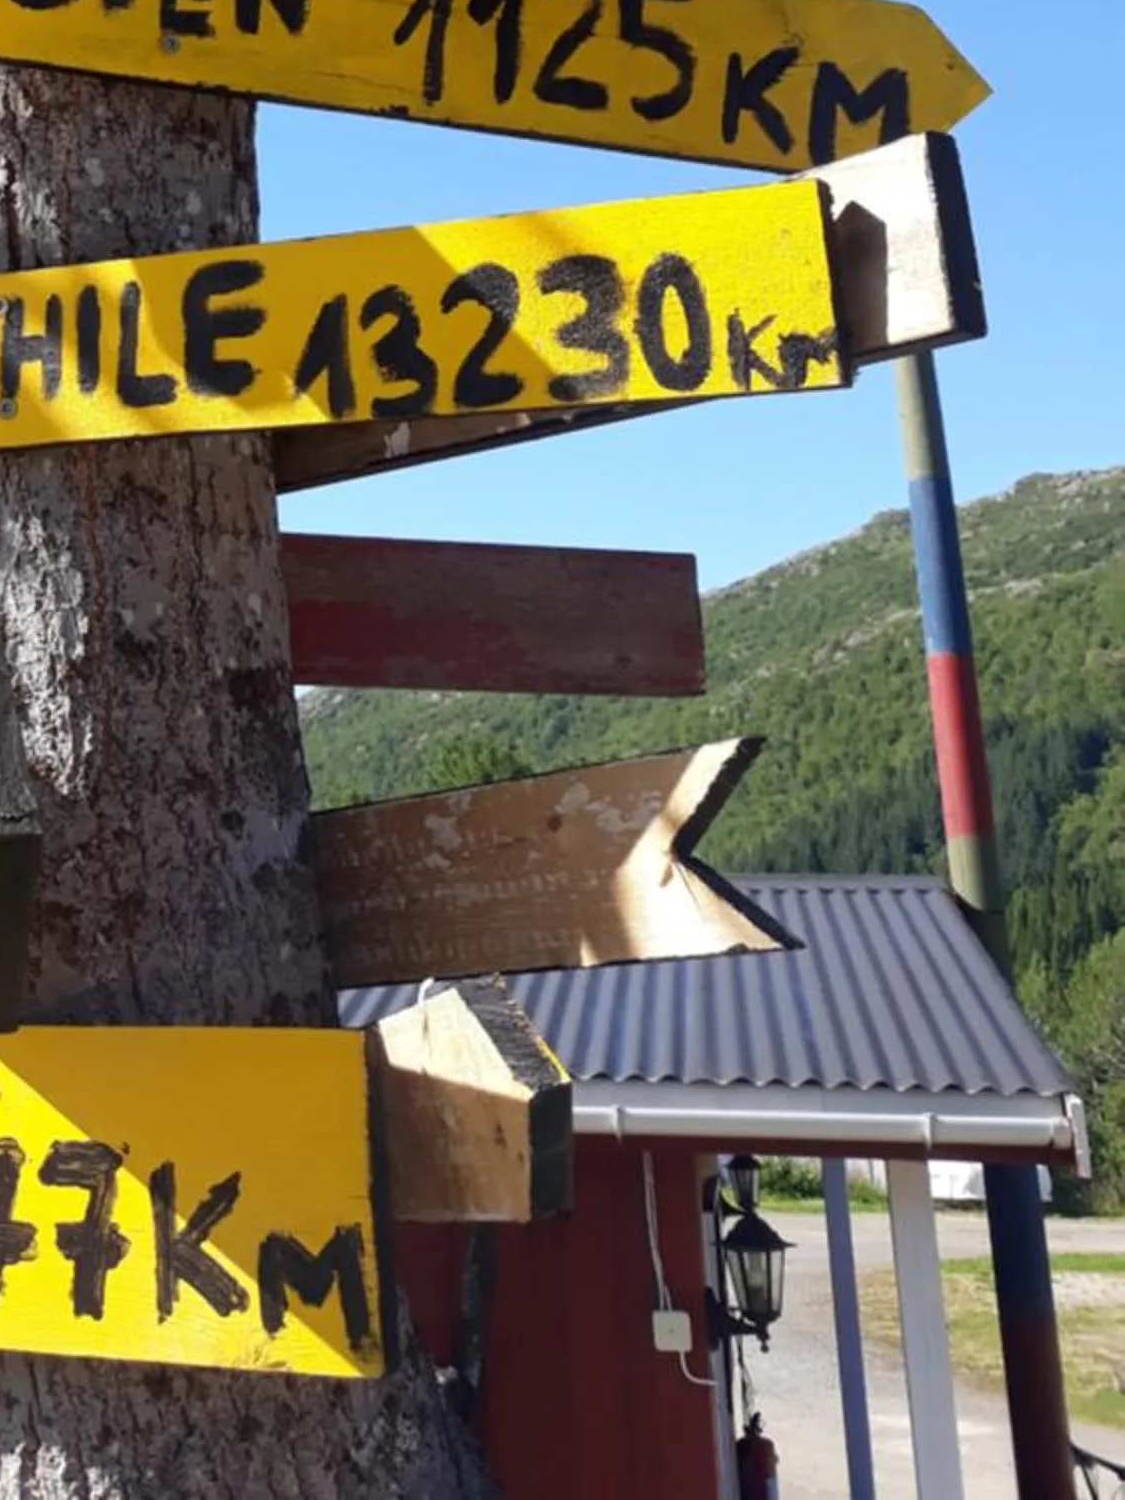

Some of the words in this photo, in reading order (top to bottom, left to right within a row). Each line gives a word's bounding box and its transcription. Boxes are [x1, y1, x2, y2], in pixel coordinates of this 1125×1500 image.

[720, 44, 912, 165] KM
[293, 251, 712, 421] 13230
[148, 1159, 374, 1356] KM
